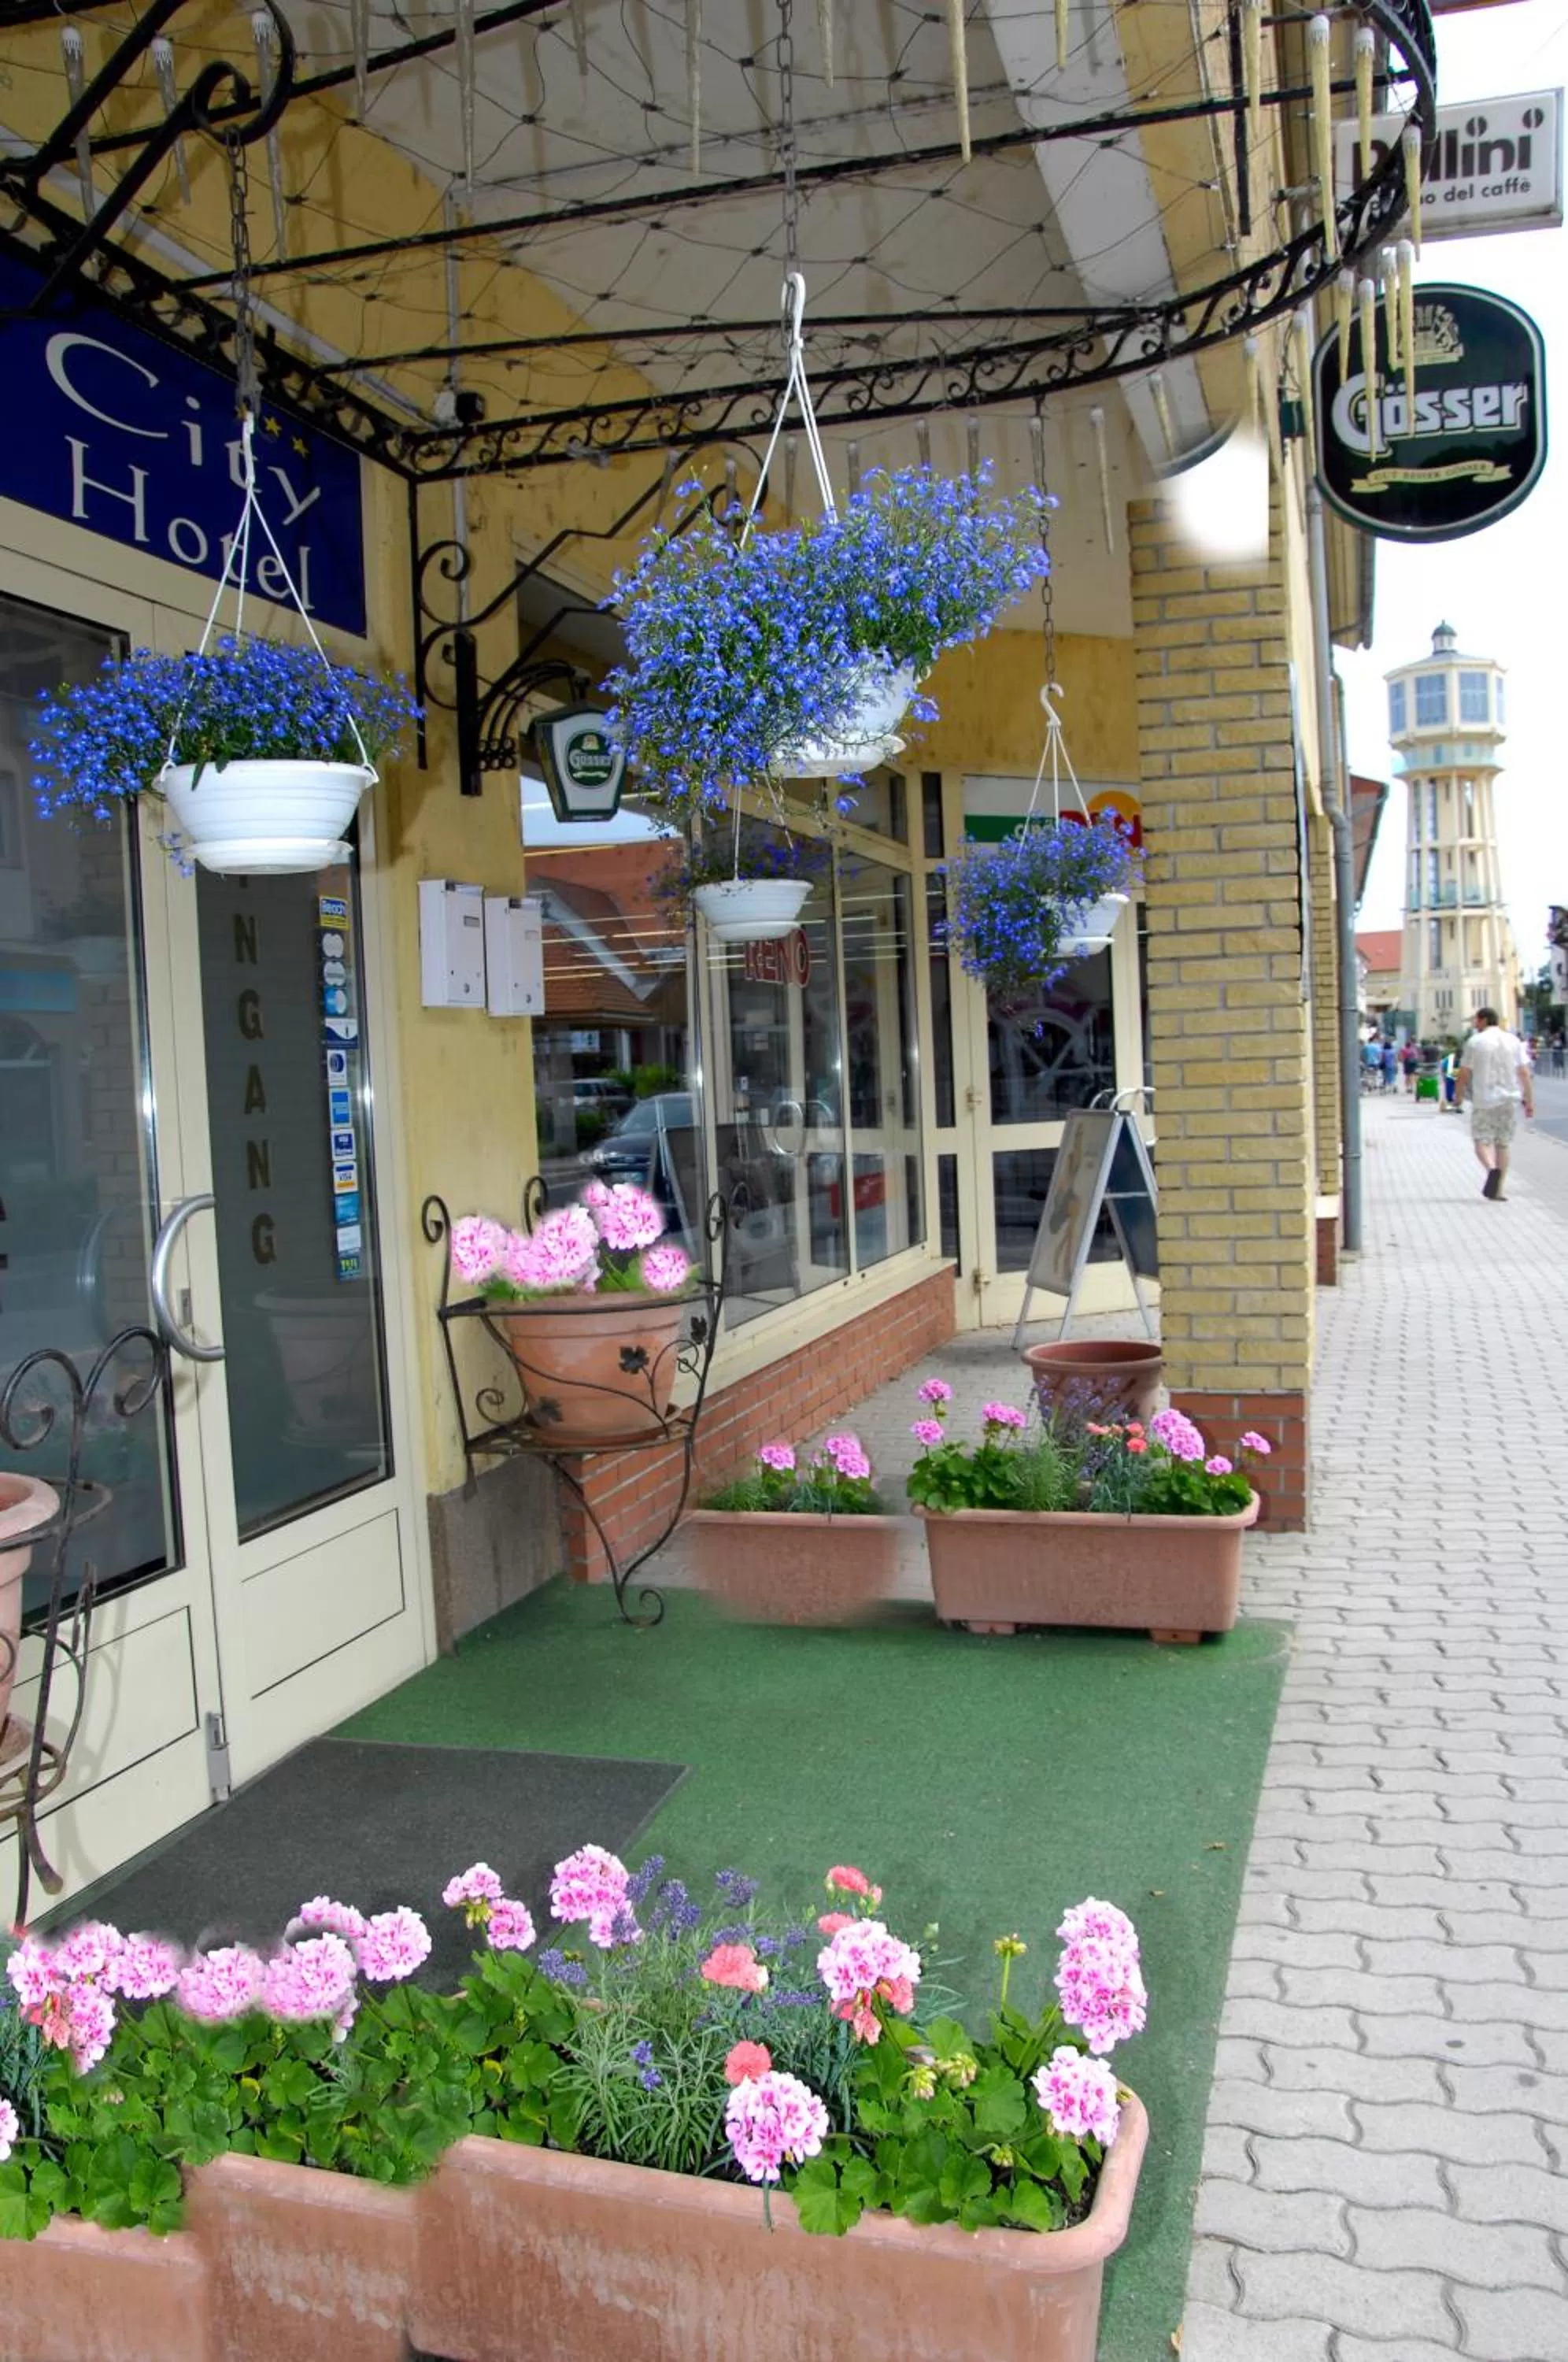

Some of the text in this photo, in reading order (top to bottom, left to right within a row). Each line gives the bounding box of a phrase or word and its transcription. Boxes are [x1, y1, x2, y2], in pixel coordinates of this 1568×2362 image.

[1444, 183, 1474, 203] del
[45, 332, 321, 526] City
[64, 435, 316, 611] Hotel
[232, 875, 277, 1265] NGANG
